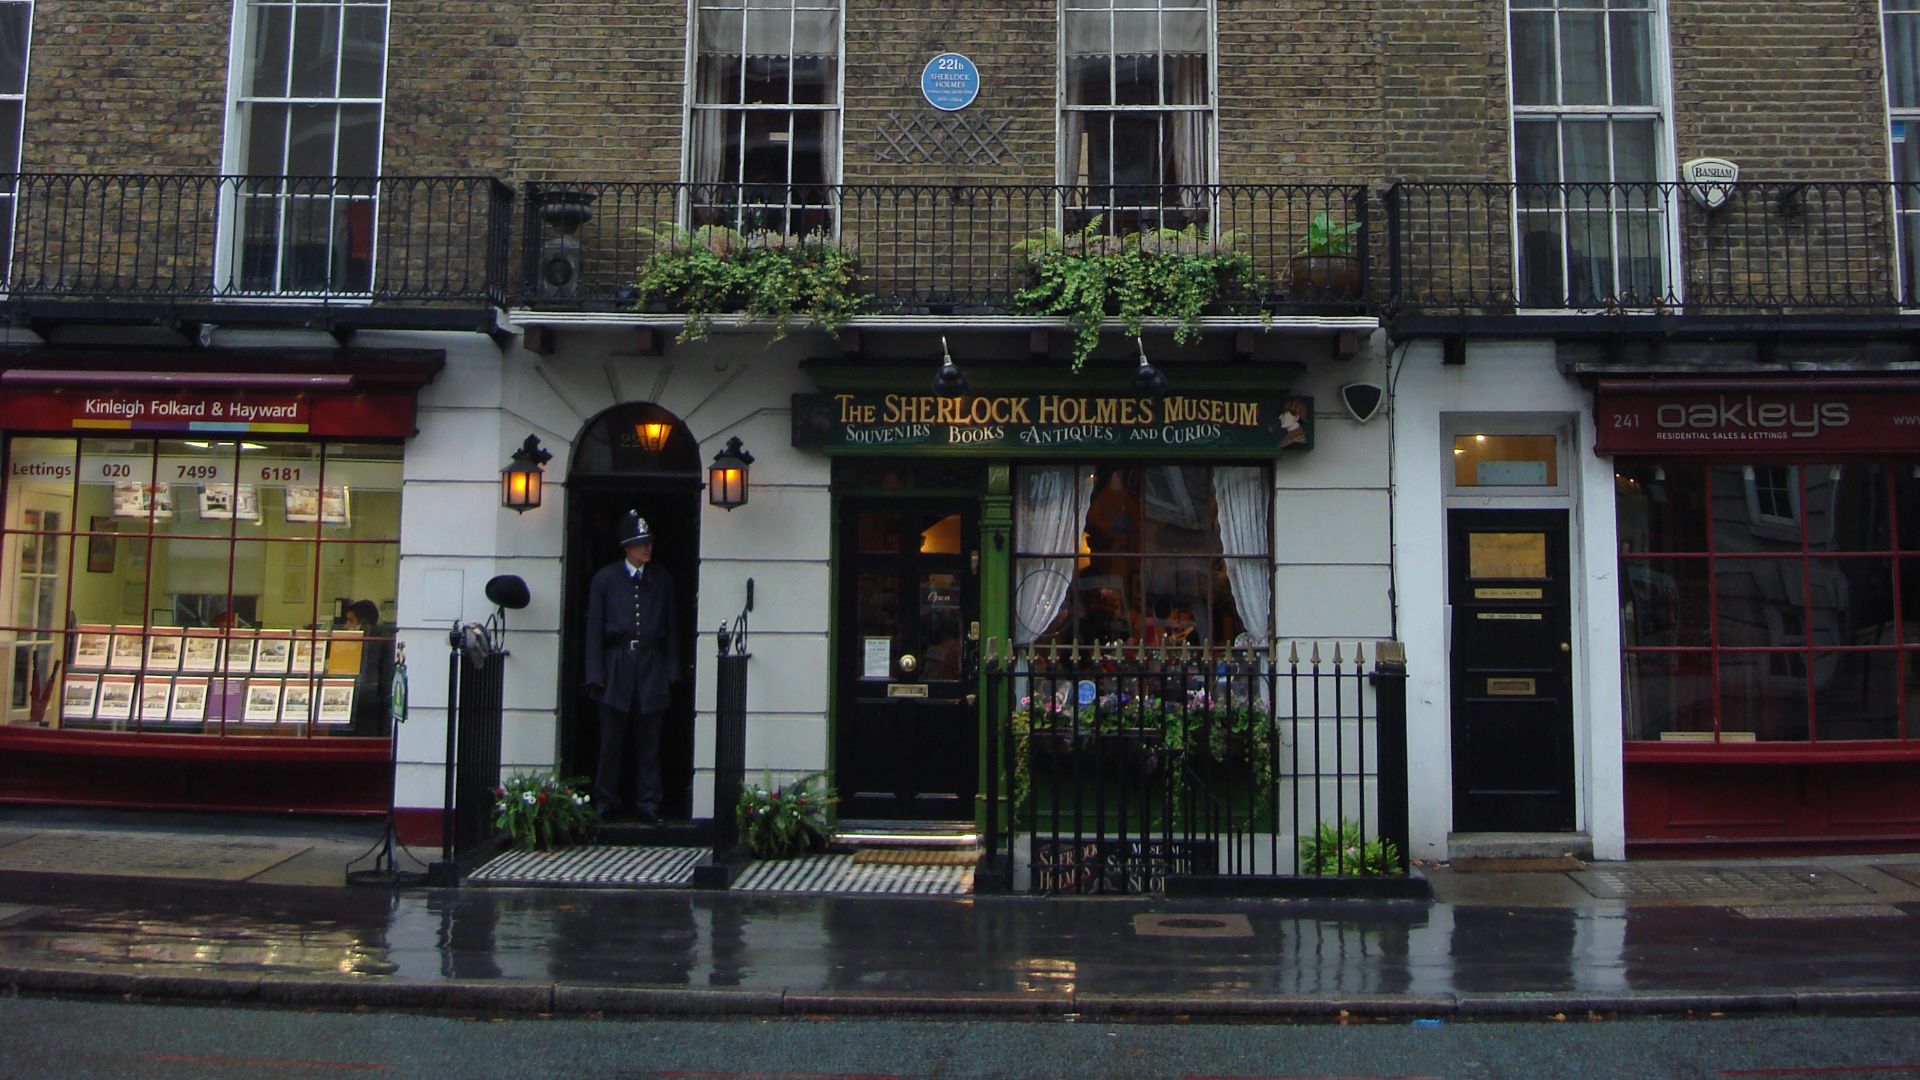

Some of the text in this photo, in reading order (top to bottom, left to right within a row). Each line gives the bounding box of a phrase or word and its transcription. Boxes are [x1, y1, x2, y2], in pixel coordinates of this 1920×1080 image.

[939, 59, 964, 70] 221b
[930, 73, 970, 81] SHERLOCK
[1695, 167, 1732, 178] BANHAM
[85, 399, 297, 419] Kinleigh Folkard & Hayward
[834, 393, 1259, 426] THE SHERLOCK HOLMES MUSEUM
[1656, 395, 1850, 437] oakleys
[1613, 414, 1639, 428] 241
[846, 423, 1221, 444] SOUVENIRS BOOKS ANTIQUES AND CURIOS
[1656, 432, 1710, 440] RESIDENTIAL
[1713, 432, 1739, 440] SALES
[1748, 432, 1788, 440] LETTINGS
[12, 462, 71, 477] Lettings
[102, 464, 131, 477] 020
[177, 465, 217, 480] 7499
[261, 467, 301, 481] 6181
[927, 591, 951, 602] Open
